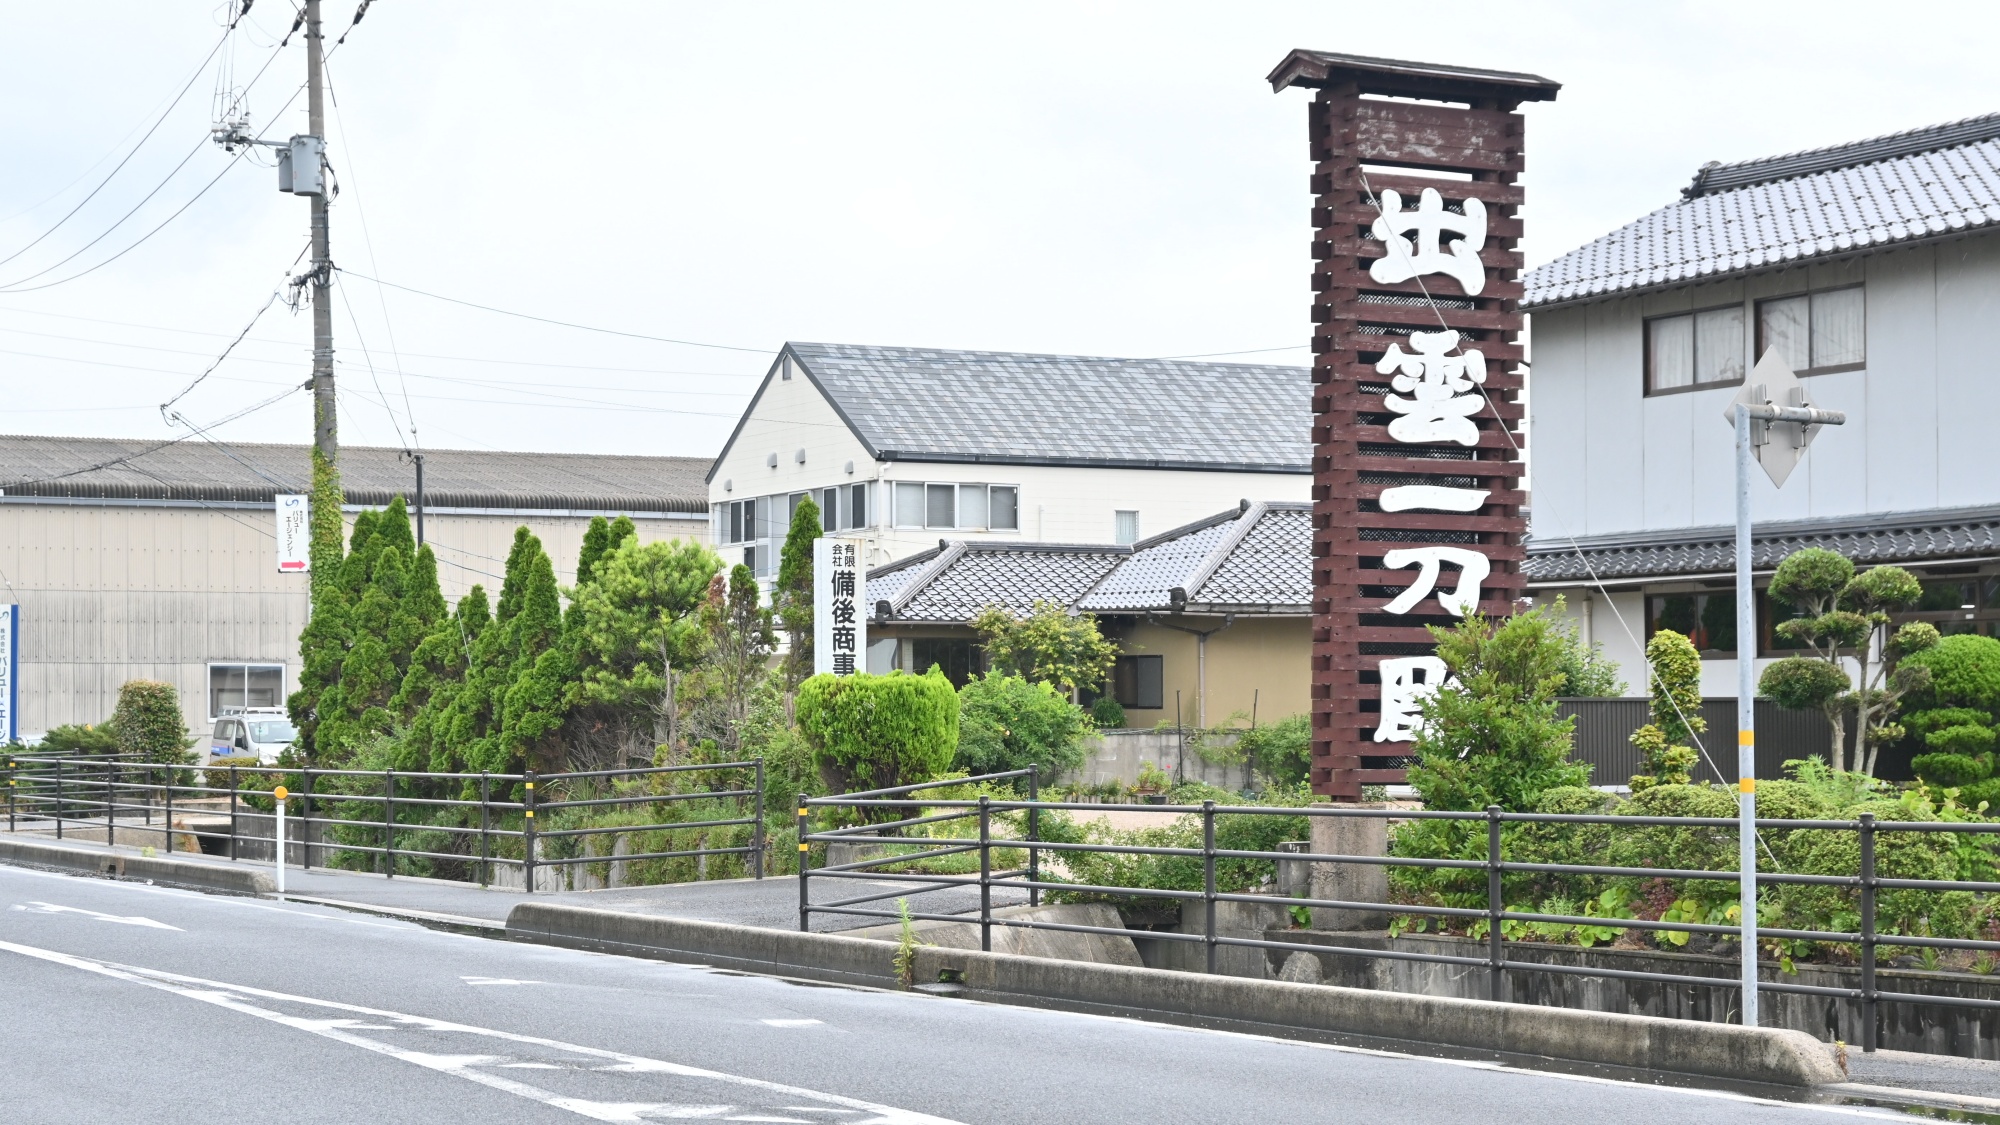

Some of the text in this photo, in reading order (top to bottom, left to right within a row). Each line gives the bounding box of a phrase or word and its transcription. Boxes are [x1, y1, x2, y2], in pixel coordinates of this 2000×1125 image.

[831, 543, 843, 568] 会社
[844, 544, 856, 568] 有限
[830, 569, 857, 677] 備後商事
